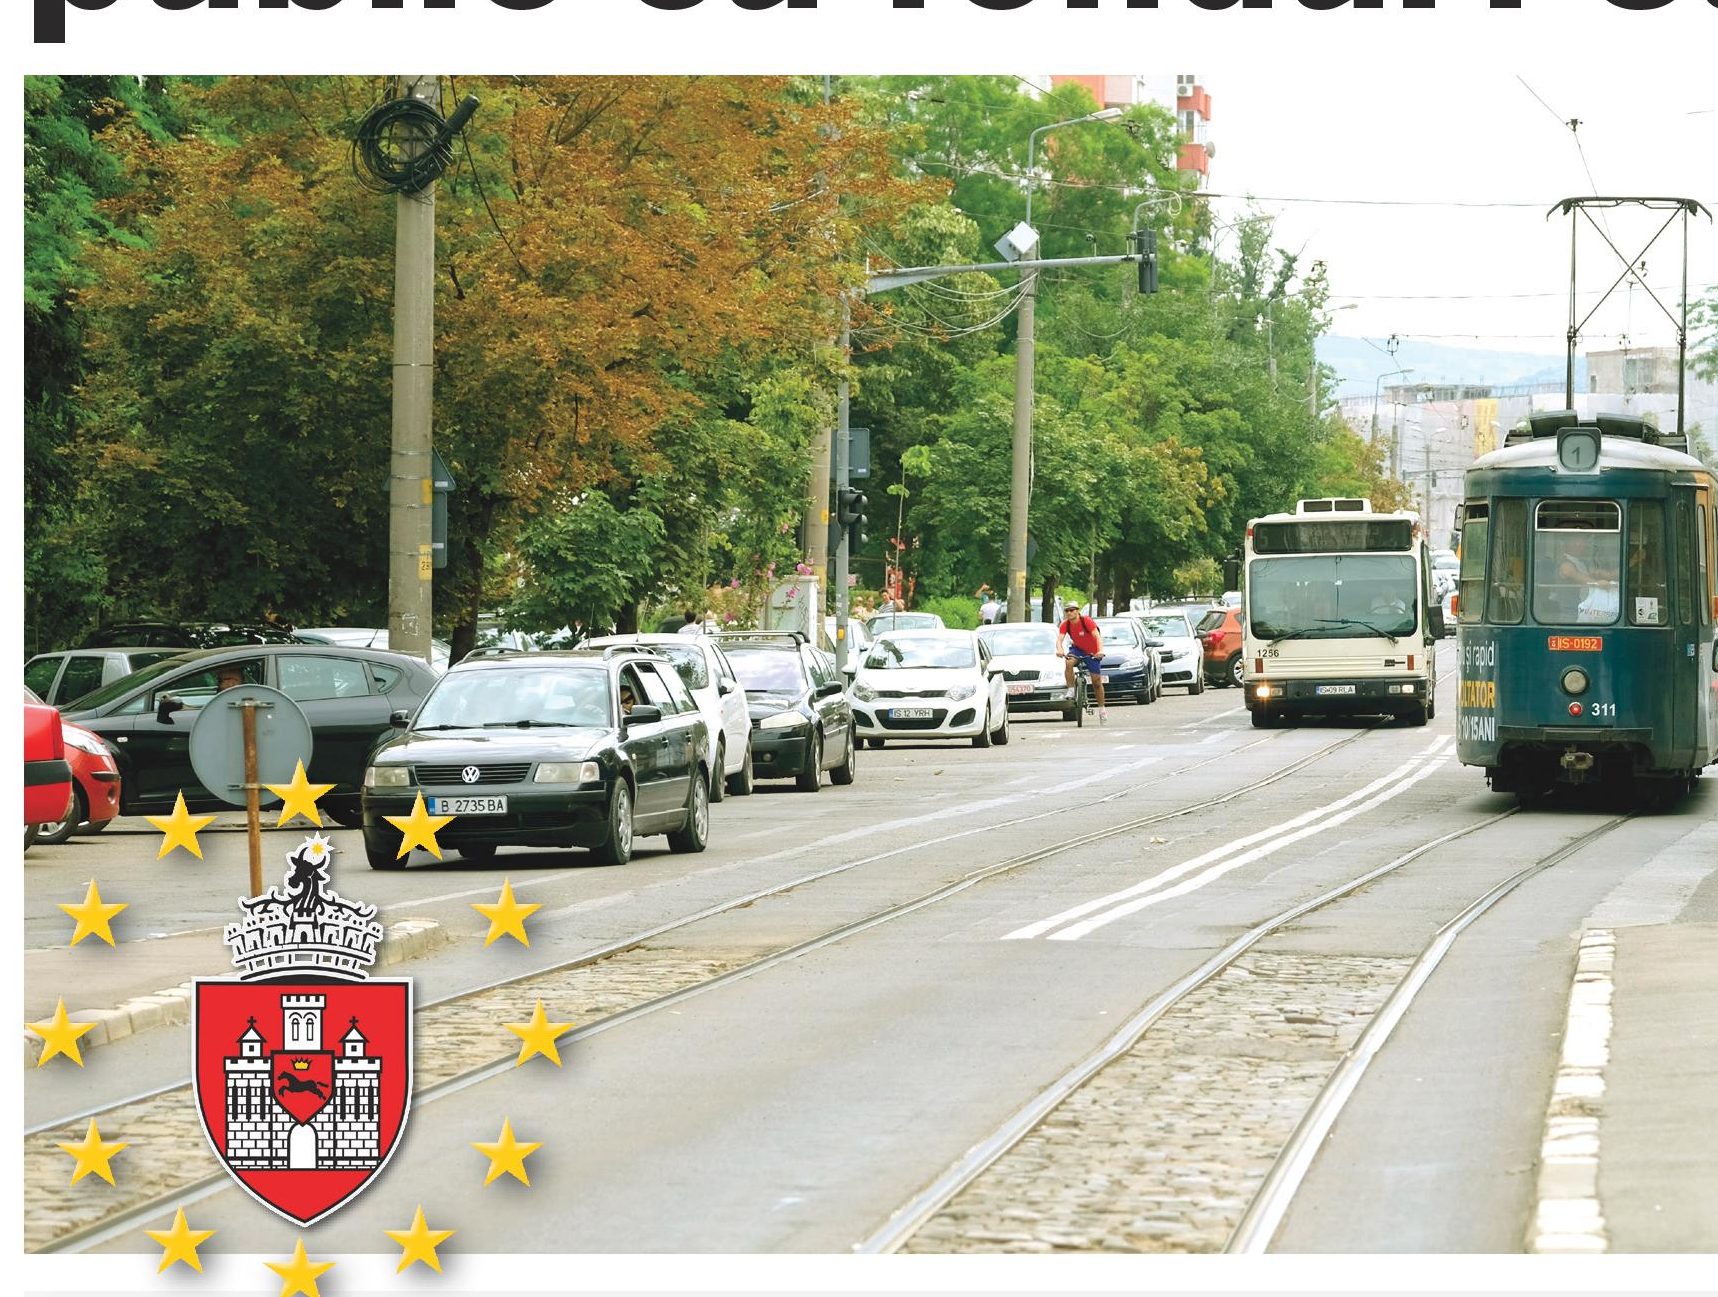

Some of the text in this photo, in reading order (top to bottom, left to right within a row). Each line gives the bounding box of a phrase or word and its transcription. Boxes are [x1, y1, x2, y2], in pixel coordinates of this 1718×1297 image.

[1571, 446, 1580, 464] 1
[1257, 649, 1279, 658] 1256
[1473, 640, 1495, 674] rapid
[892, 708, 931, 717] IS 12 YRH
[1591, 703, 1616, 716] 311
[441, 800, 504, 812] B 2735 BA
